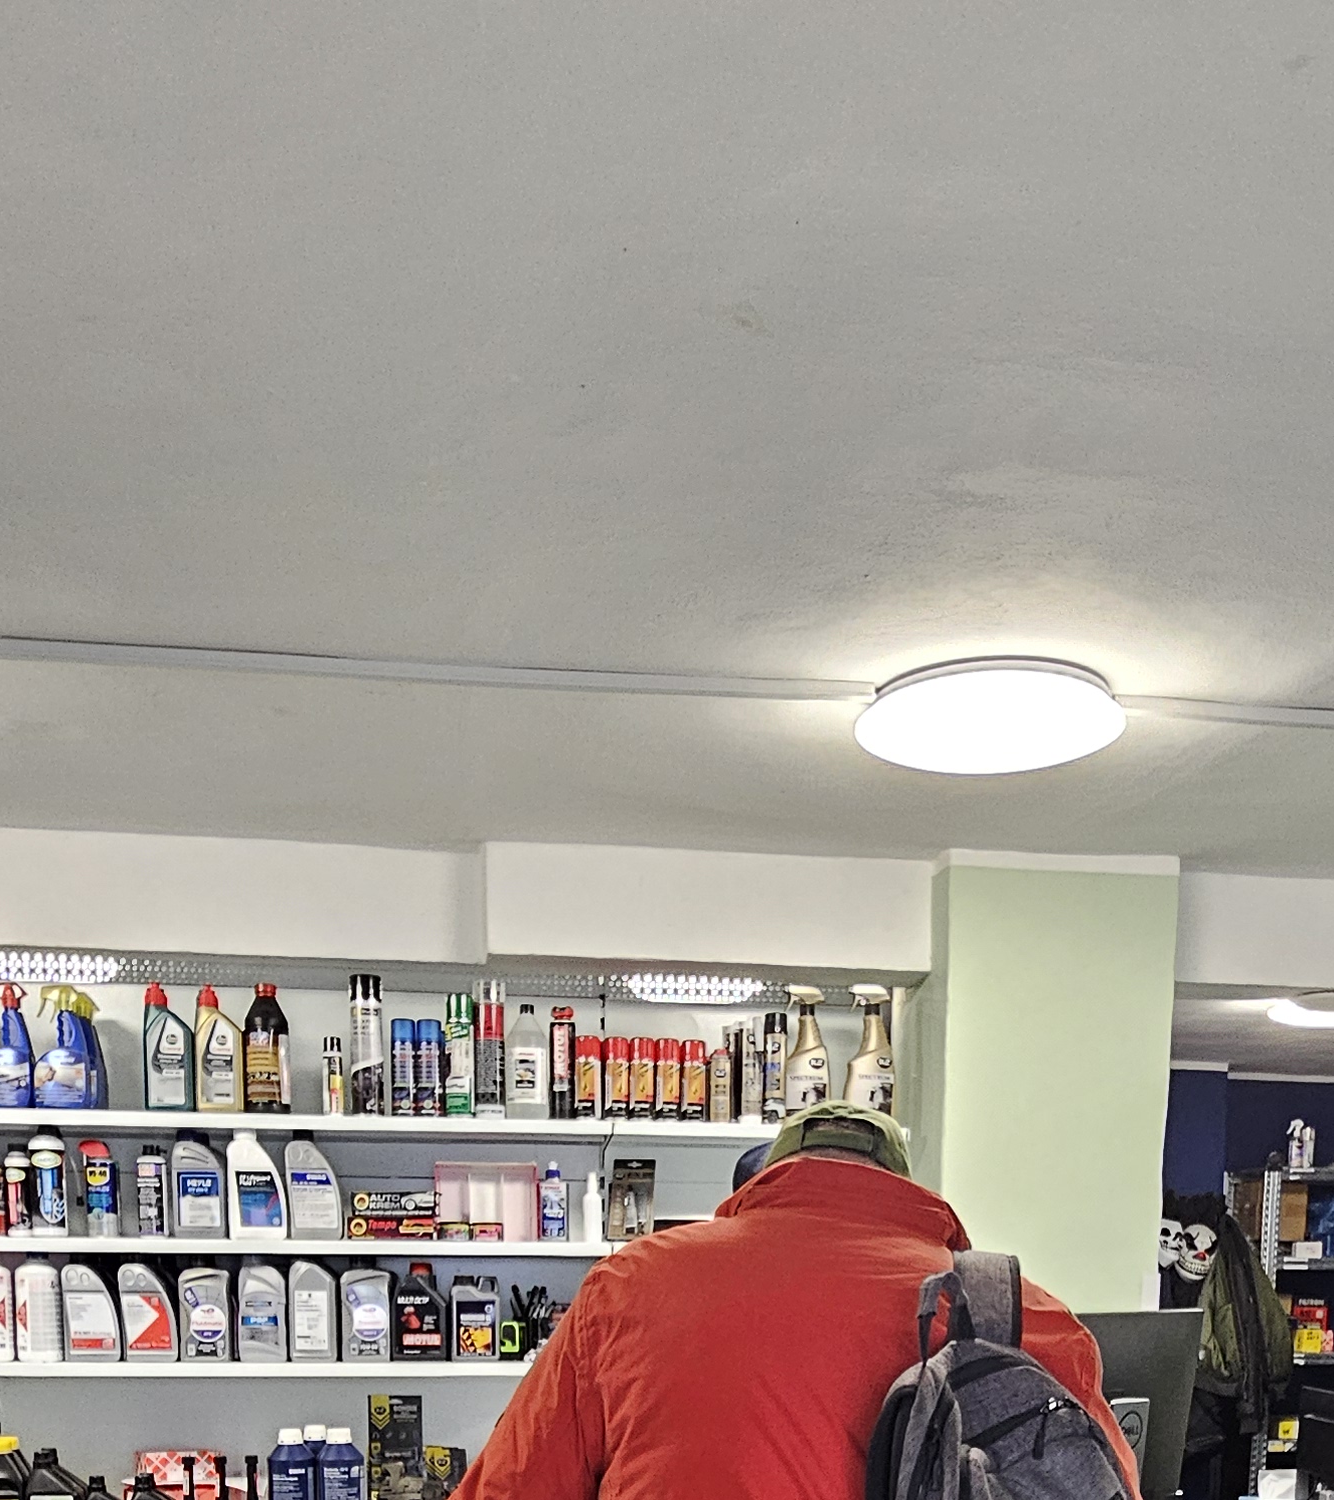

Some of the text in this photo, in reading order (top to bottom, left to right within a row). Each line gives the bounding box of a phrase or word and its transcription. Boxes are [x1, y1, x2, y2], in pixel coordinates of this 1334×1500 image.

[554, 1025, 568, 1077] MOTUL
[186, 1179, 211, 1188] MEYLE
[369, 1194, 400, 1202] AUTO
[368, 1220, 397, 1231] Tempo
[404, 1334, 440, 1345] MOTUL
